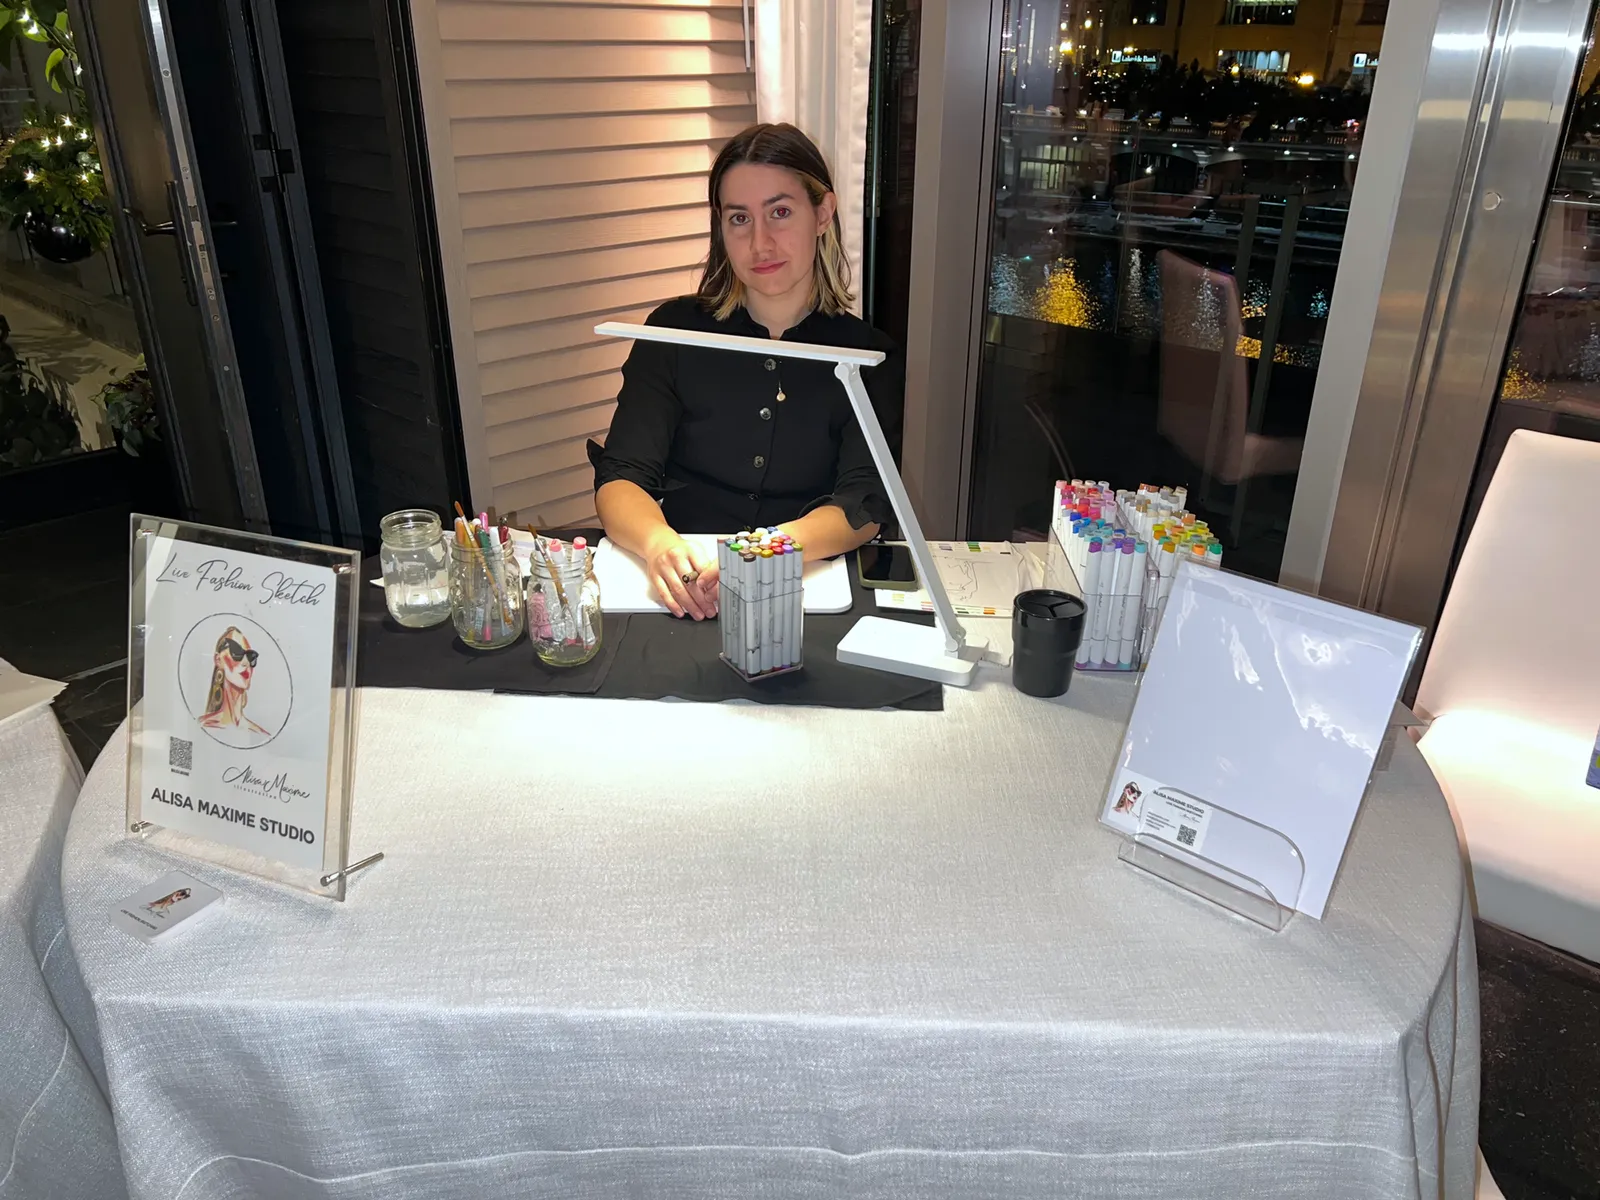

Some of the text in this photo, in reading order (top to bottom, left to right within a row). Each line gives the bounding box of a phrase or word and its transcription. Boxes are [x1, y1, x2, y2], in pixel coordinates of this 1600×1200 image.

[156, 553, 326, 606] Live Fashion Sketch
[151, 787, 315, 844] ALISA MAXIME STUDIO
